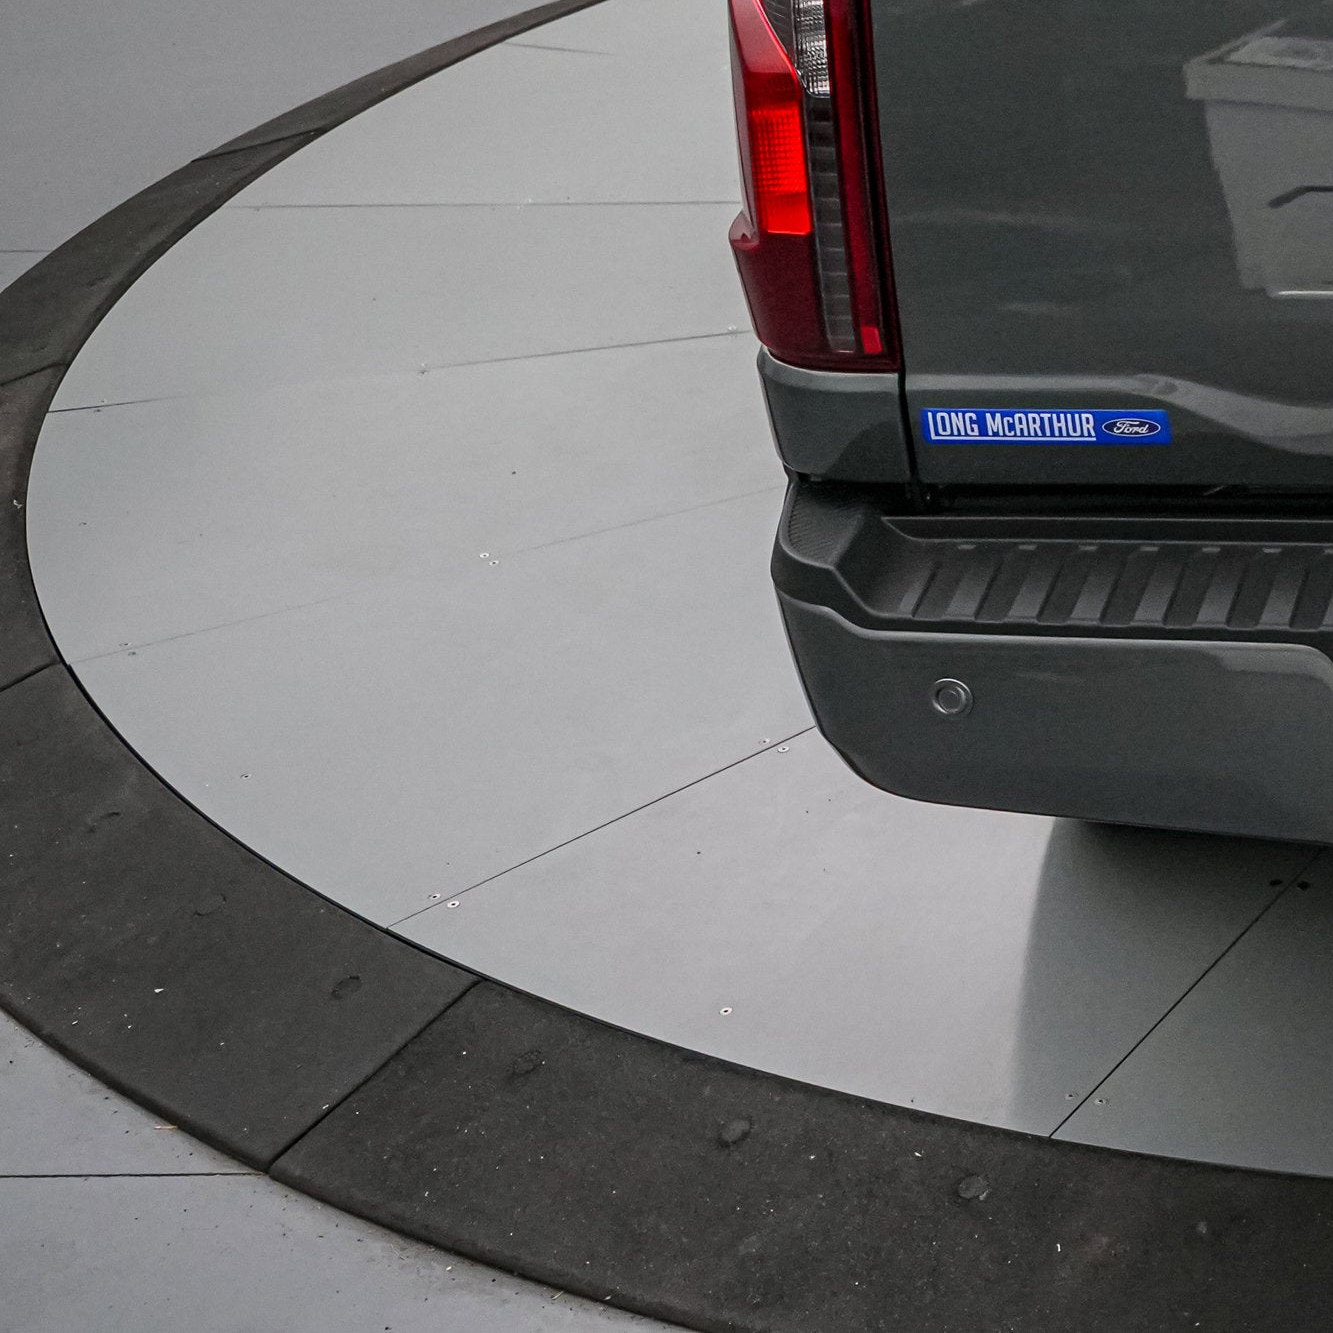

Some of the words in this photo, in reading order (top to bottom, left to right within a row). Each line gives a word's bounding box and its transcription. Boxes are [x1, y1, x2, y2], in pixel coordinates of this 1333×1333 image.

[927, 411, 979, 438] LONG
[985, 412, 1096, 437] McARTHUR
[1112, 419, 1150, 437] Ford
